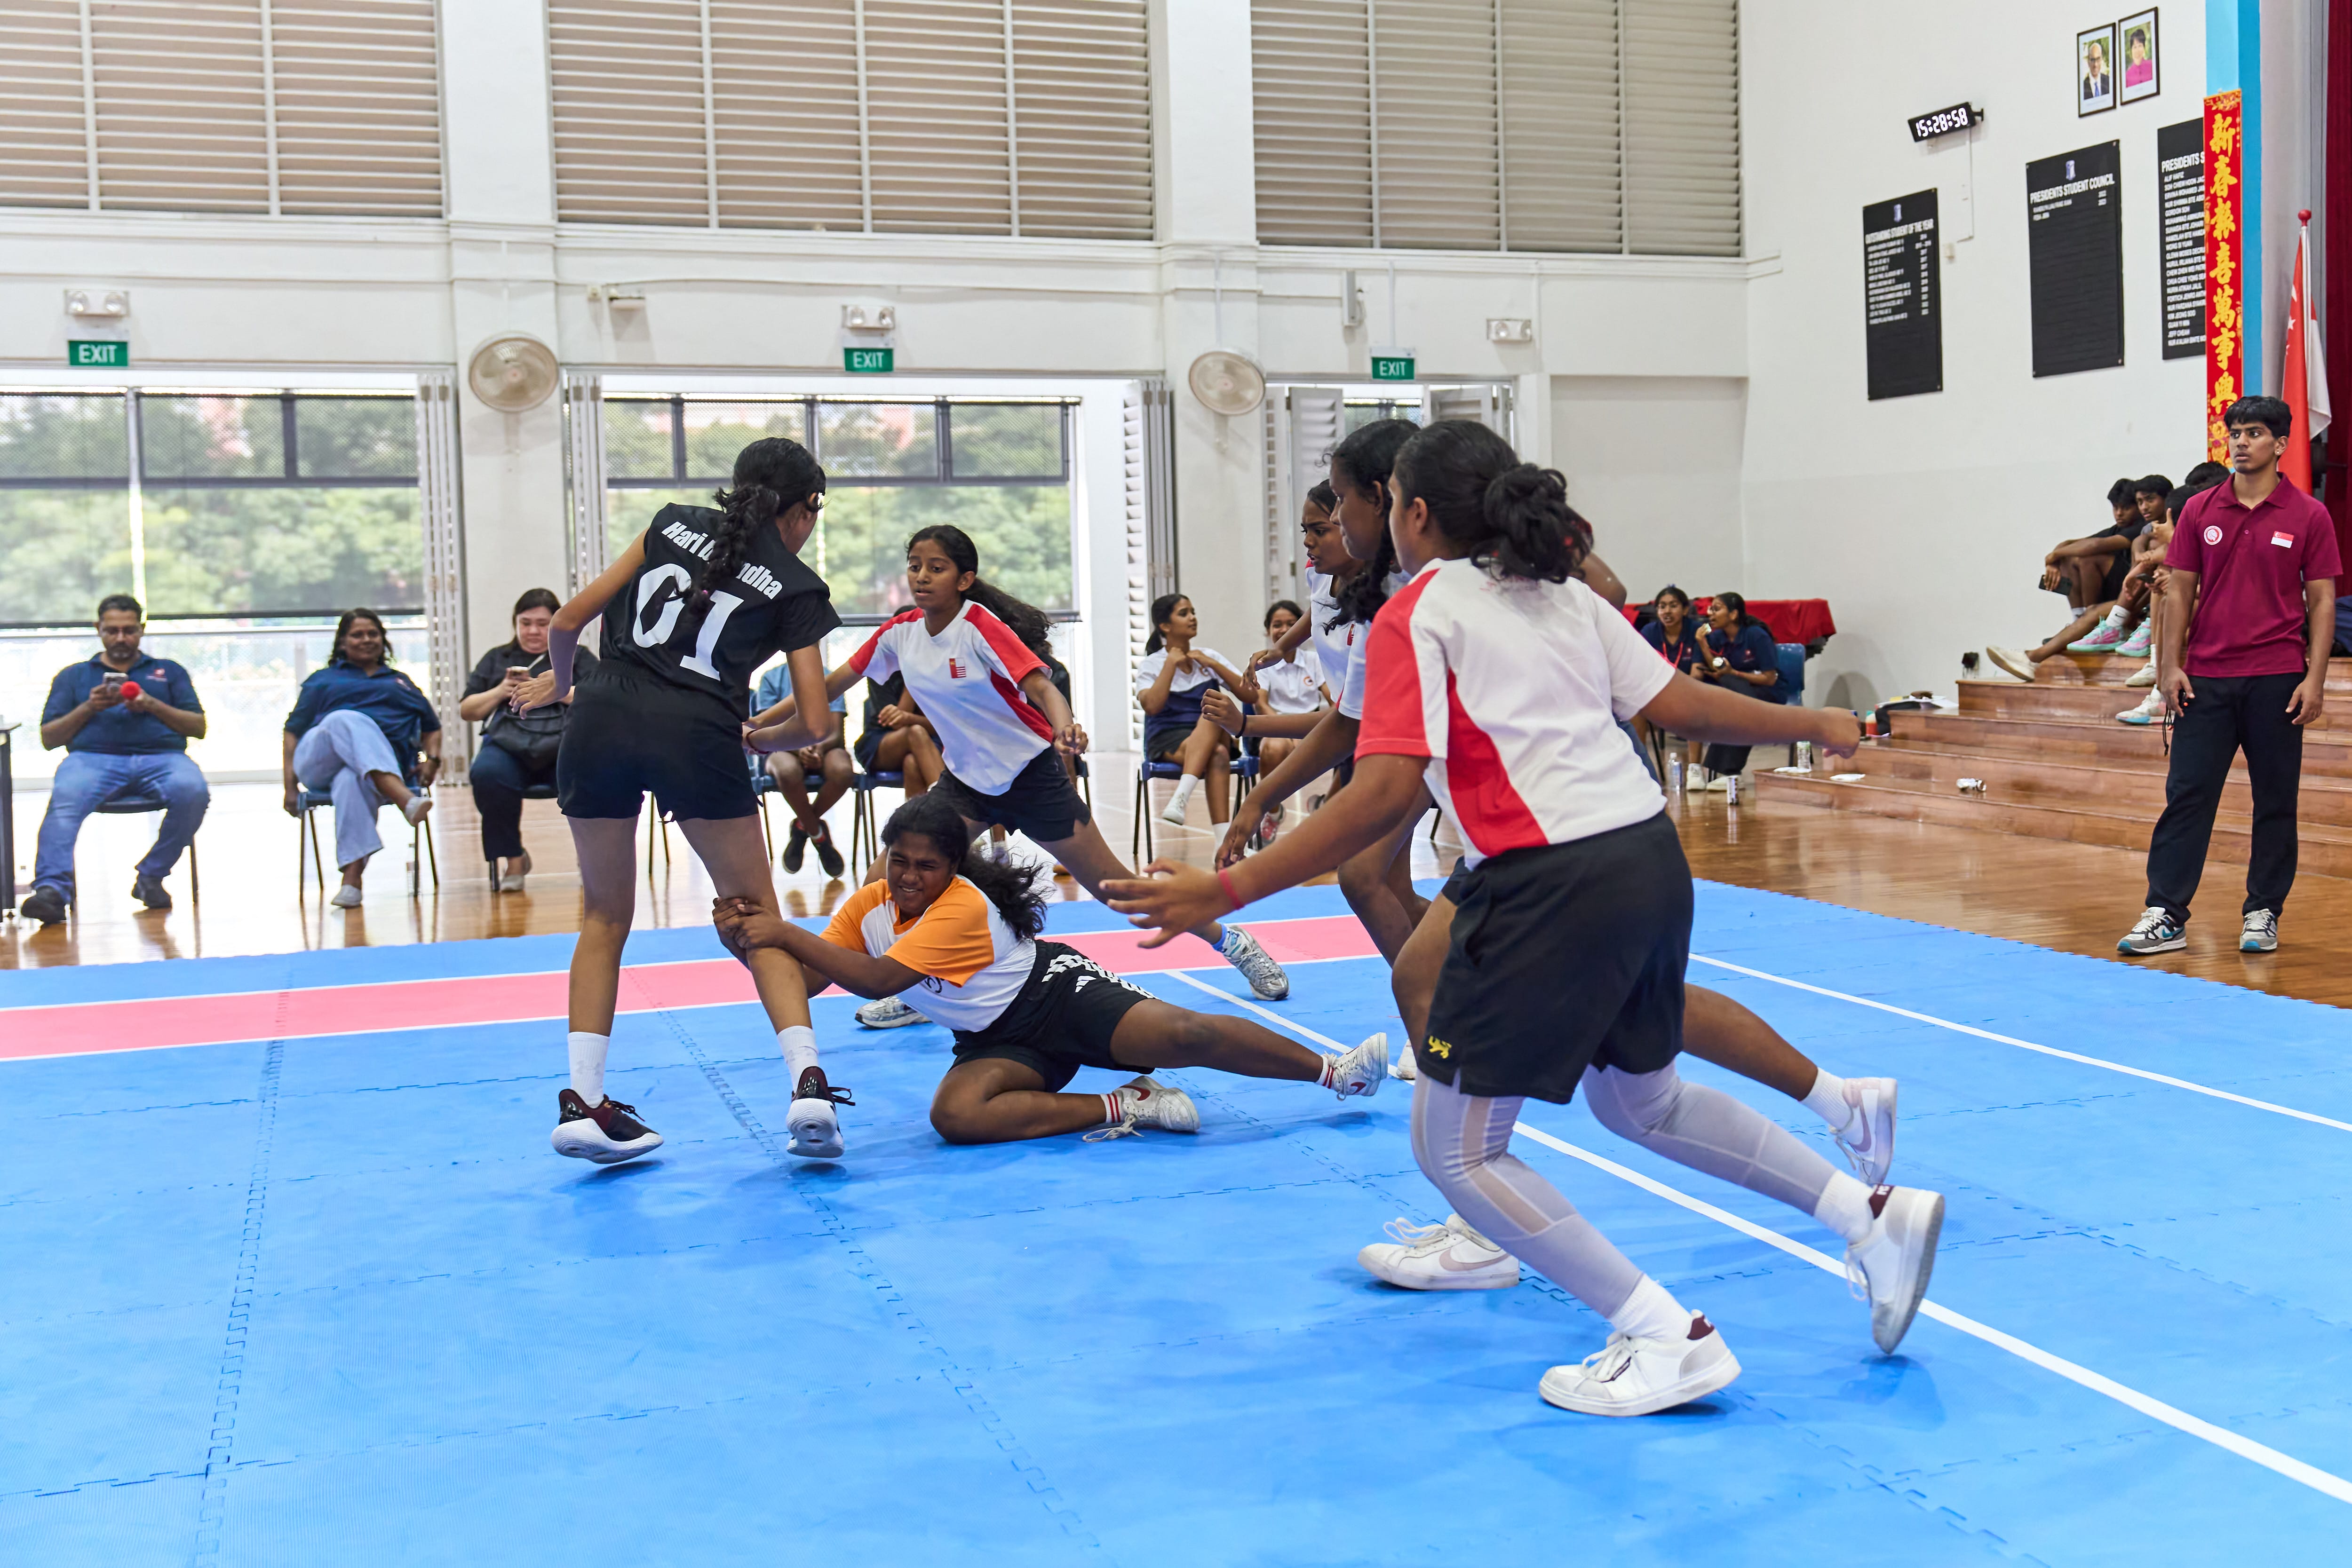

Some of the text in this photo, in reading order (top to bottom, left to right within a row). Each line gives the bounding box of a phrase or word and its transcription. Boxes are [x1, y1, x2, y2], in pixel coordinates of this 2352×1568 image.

[1915, 107, 1968, 137] 15:28:58
[2161, 152, 2200, 173] PRESIDENTS
[2030, 173, 2115, 204] PRESIDENTS STUDENT COUNCIL
[79, 344, 117, 363] EXIT
[853, 351, 884, 368] EXIT
[1379, 361, 1406, 376] EXIT
[661, 521, 708, 554] Hari
[633, 563, 744, 681] 01
